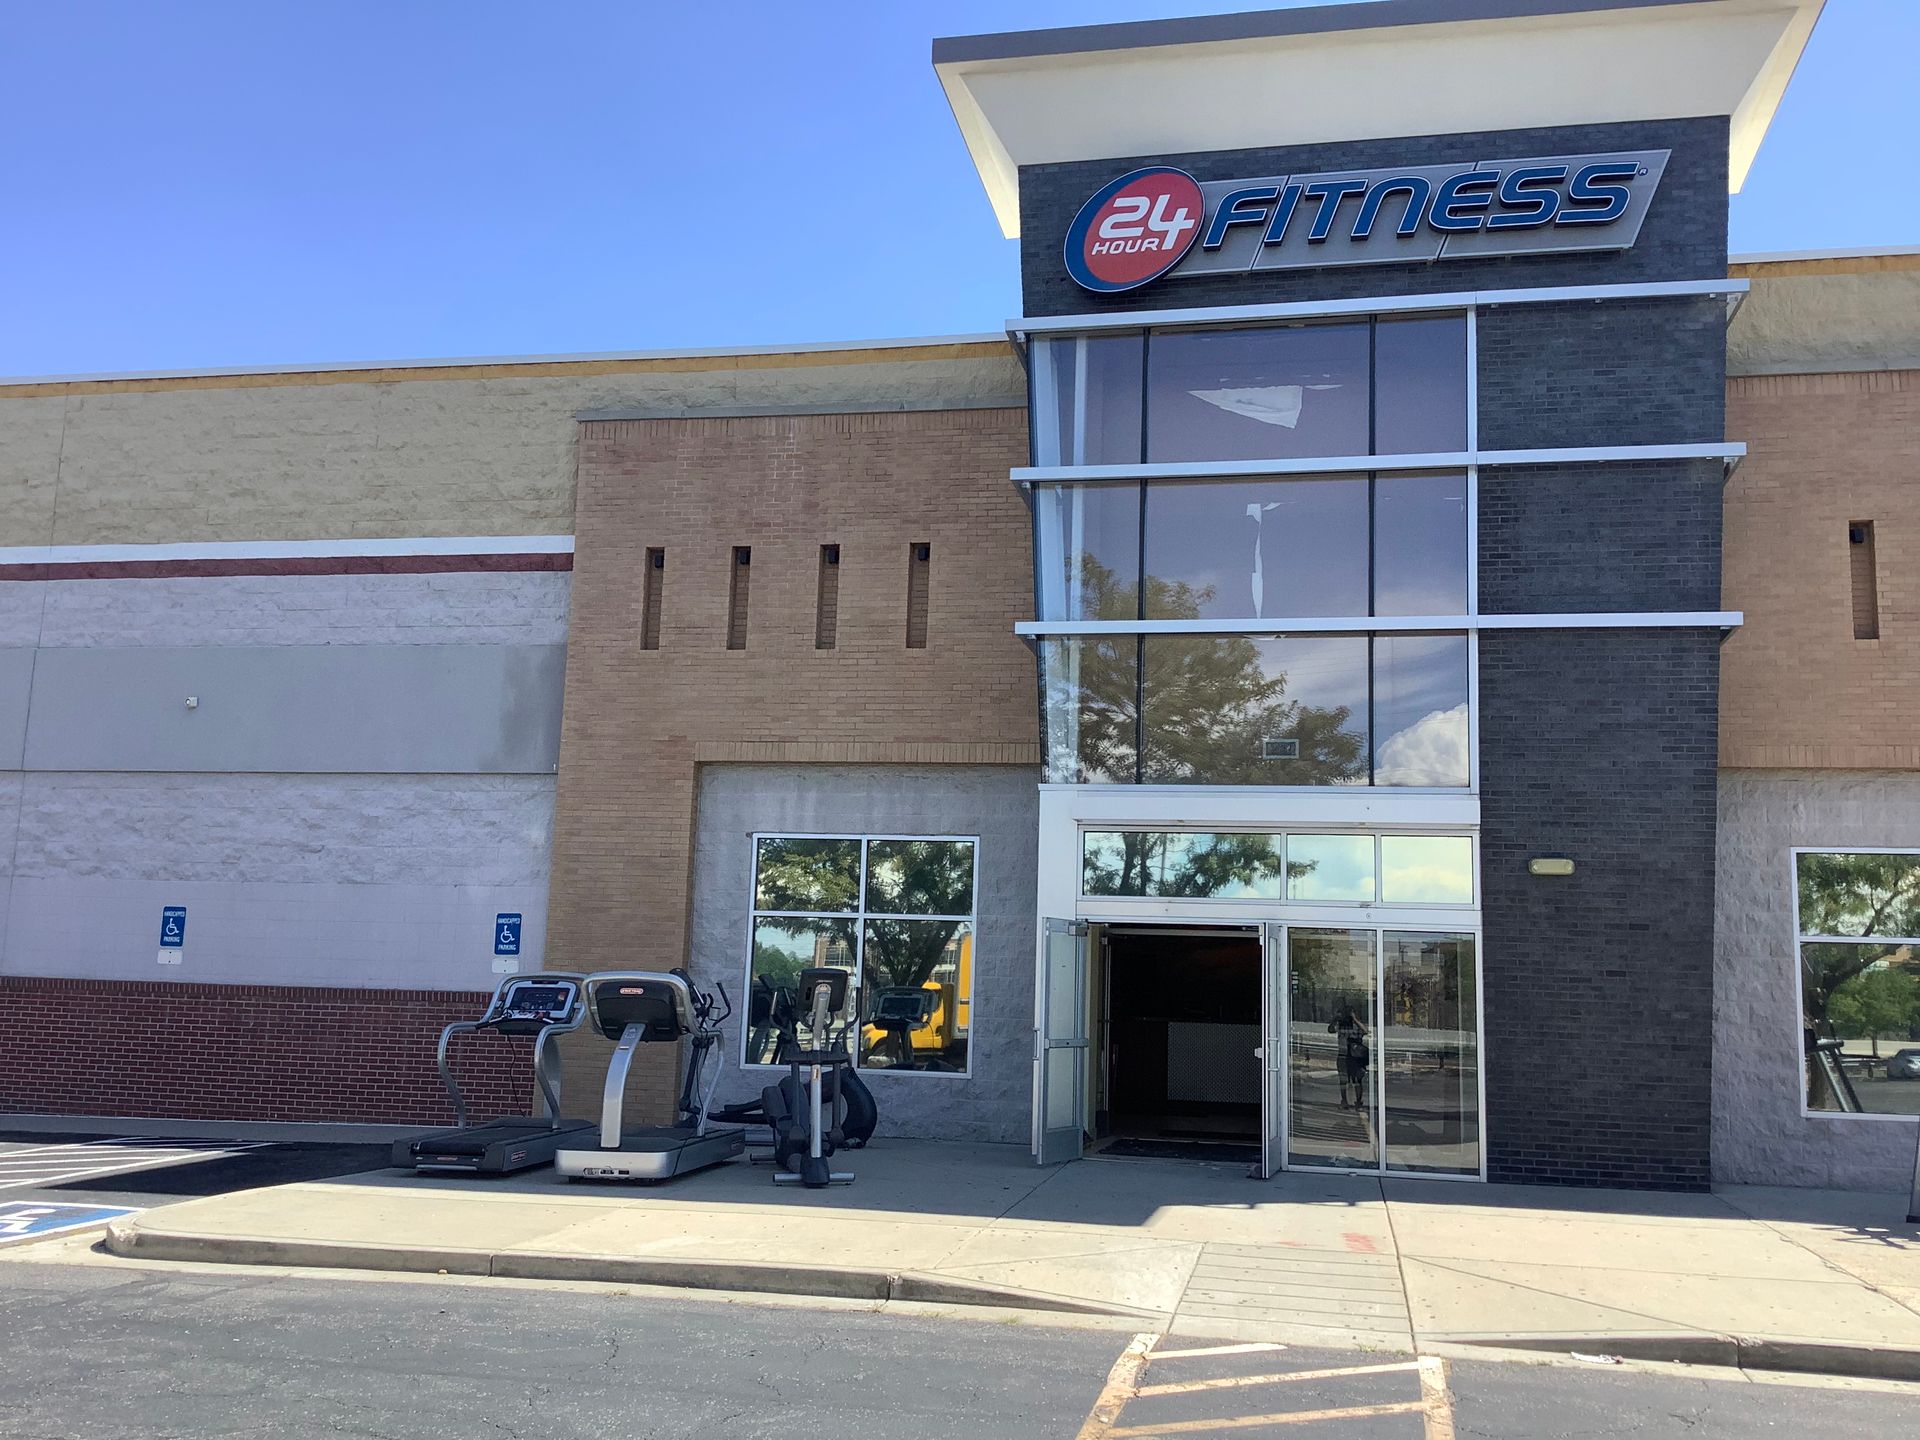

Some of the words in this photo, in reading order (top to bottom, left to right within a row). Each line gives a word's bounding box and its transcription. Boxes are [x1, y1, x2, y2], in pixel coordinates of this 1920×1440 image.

[1098, 194, 1195, 251] 24
[1202, 161, 1641, 248] FITNESS
[1091, 237, 1160, 255] HOUR
